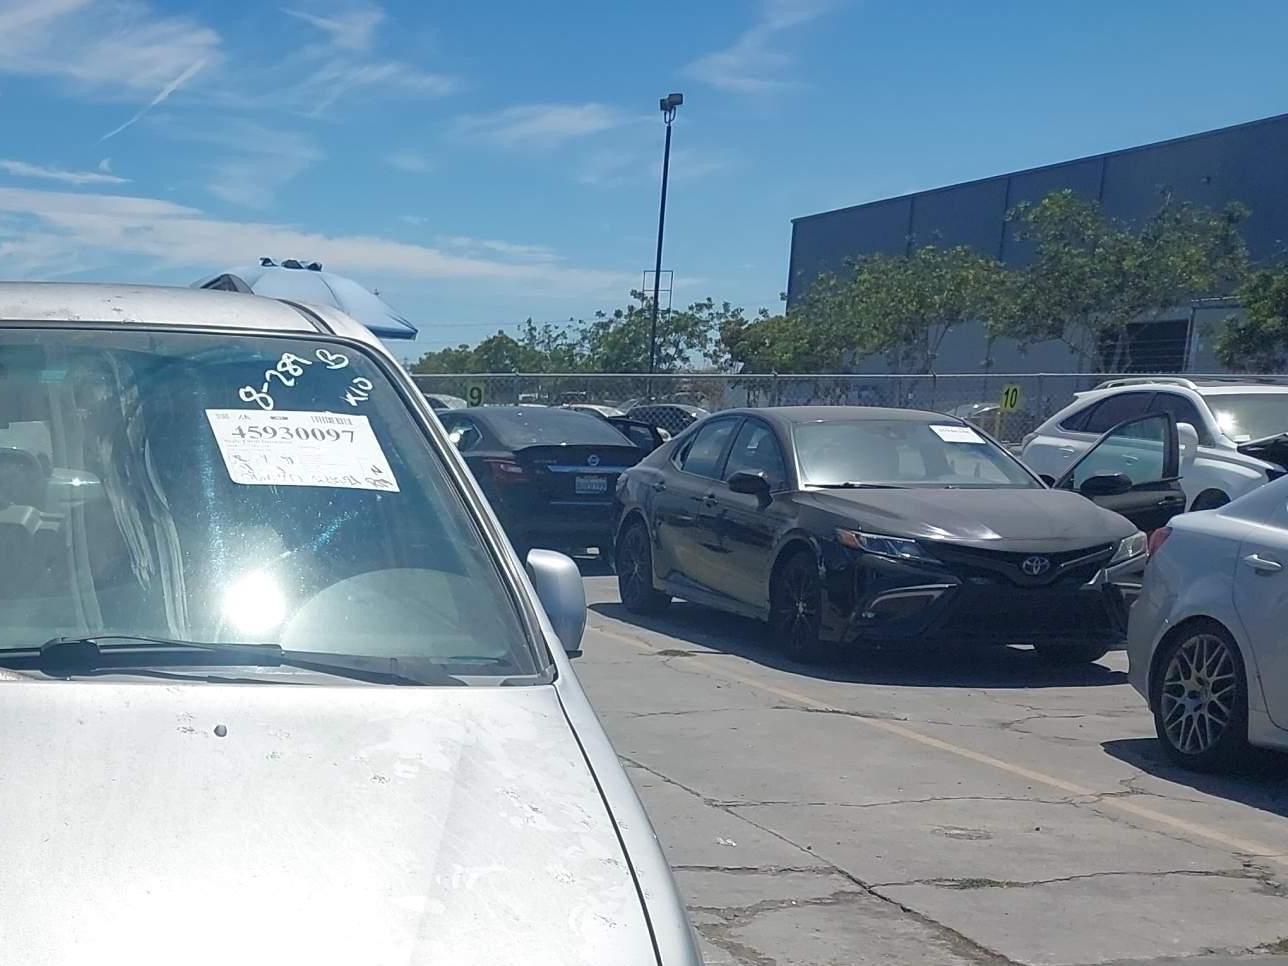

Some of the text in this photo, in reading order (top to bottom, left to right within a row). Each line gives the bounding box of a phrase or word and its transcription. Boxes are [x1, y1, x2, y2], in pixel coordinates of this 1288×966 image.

[469, 386, 482, 407] 9
[1004, 387, 1018, 409] 10
[231, 425, 355, 443] 45930097
